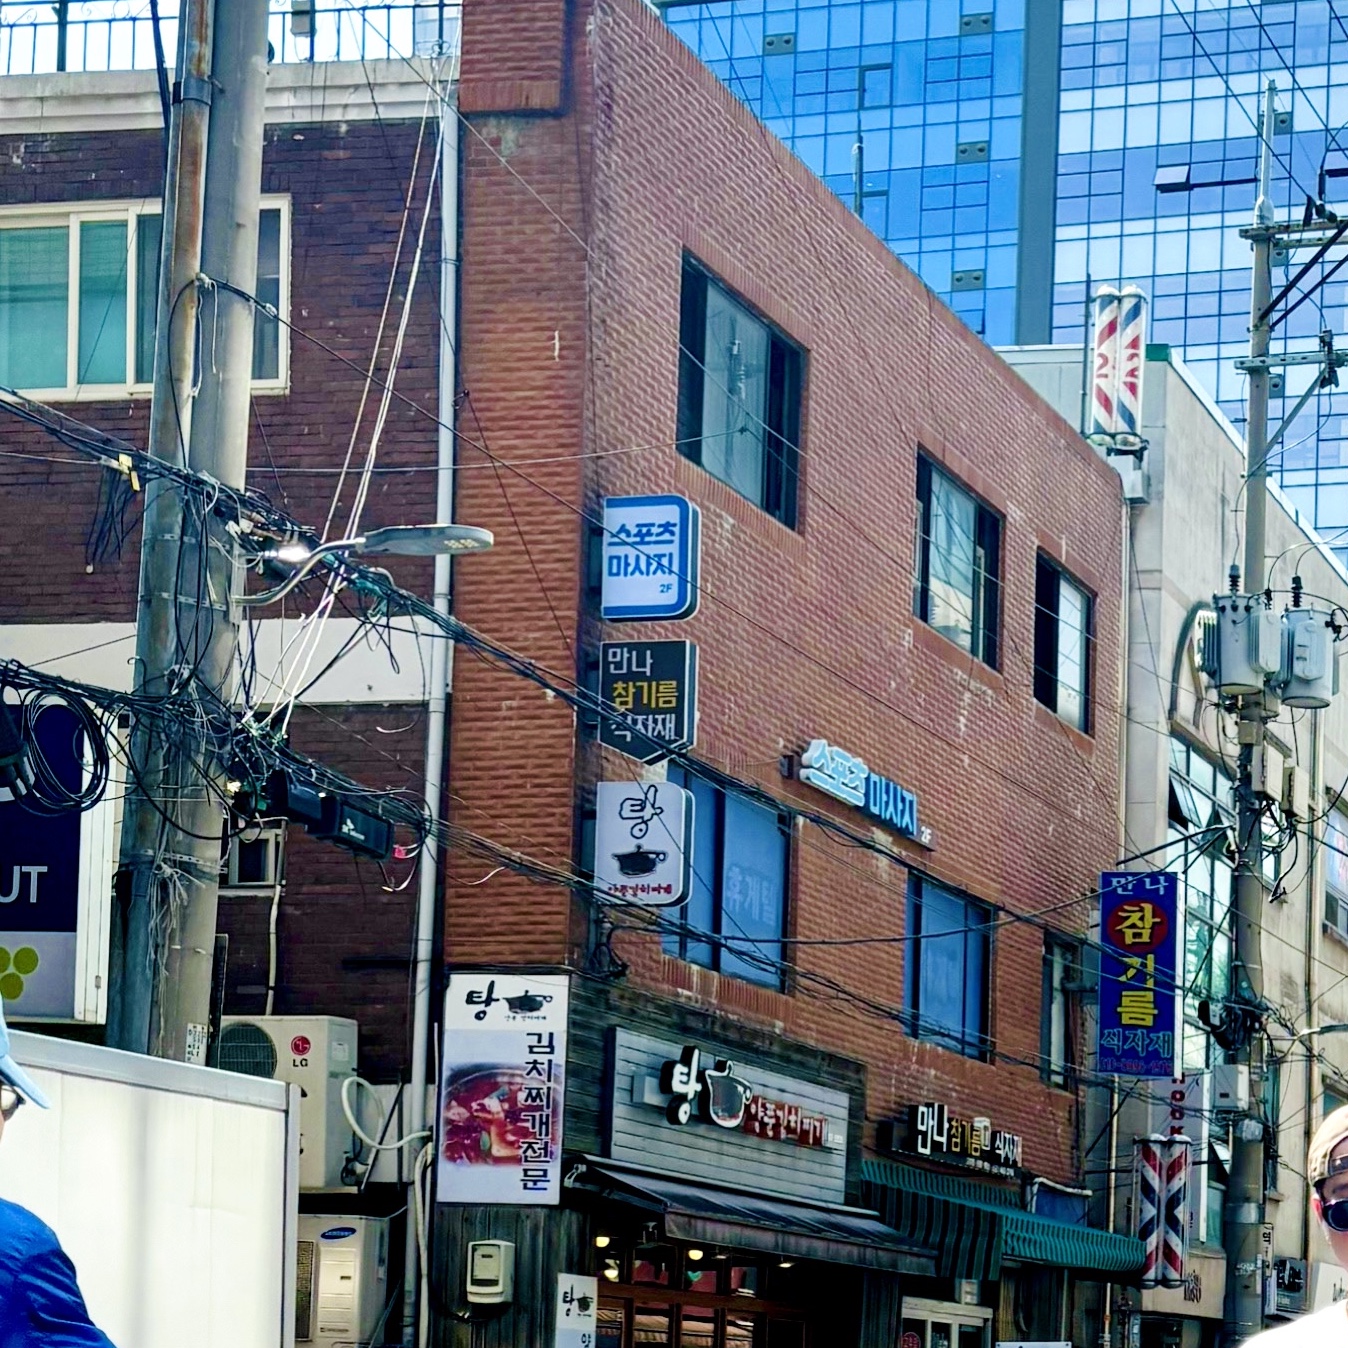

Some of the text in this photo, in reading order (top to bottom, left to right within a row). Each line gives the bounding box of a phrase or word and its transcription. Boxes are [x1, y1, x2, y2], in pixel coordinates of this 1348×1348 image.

[607, 521, 677, 547] 스포츠
[607, 552, 673, 577] 마사지
[659, 584, 673, 593] 2F
[607, 648, 653, 676] 만나
[613, 680, 678, 709] 참기름
[800, 739, 868, 807] 스포츠
[869, 772, 917, 836] 마사지
[1110, 876, 1169, 895] 만나
[1116, 902, 1161, 1027] 참기름
[465, 980, 500, 1021] 탕
[1101, 1028, 1173, 1058] 식자재
[292, 1059, 309, 1068] LG
[659, 1045, 702, 1126] 탕
[520, 1032, 555, 1191] 김치찌개전문
[917, 1102, 950, 1156] 만나
[950, 1119, 981, 1157] 참기름
